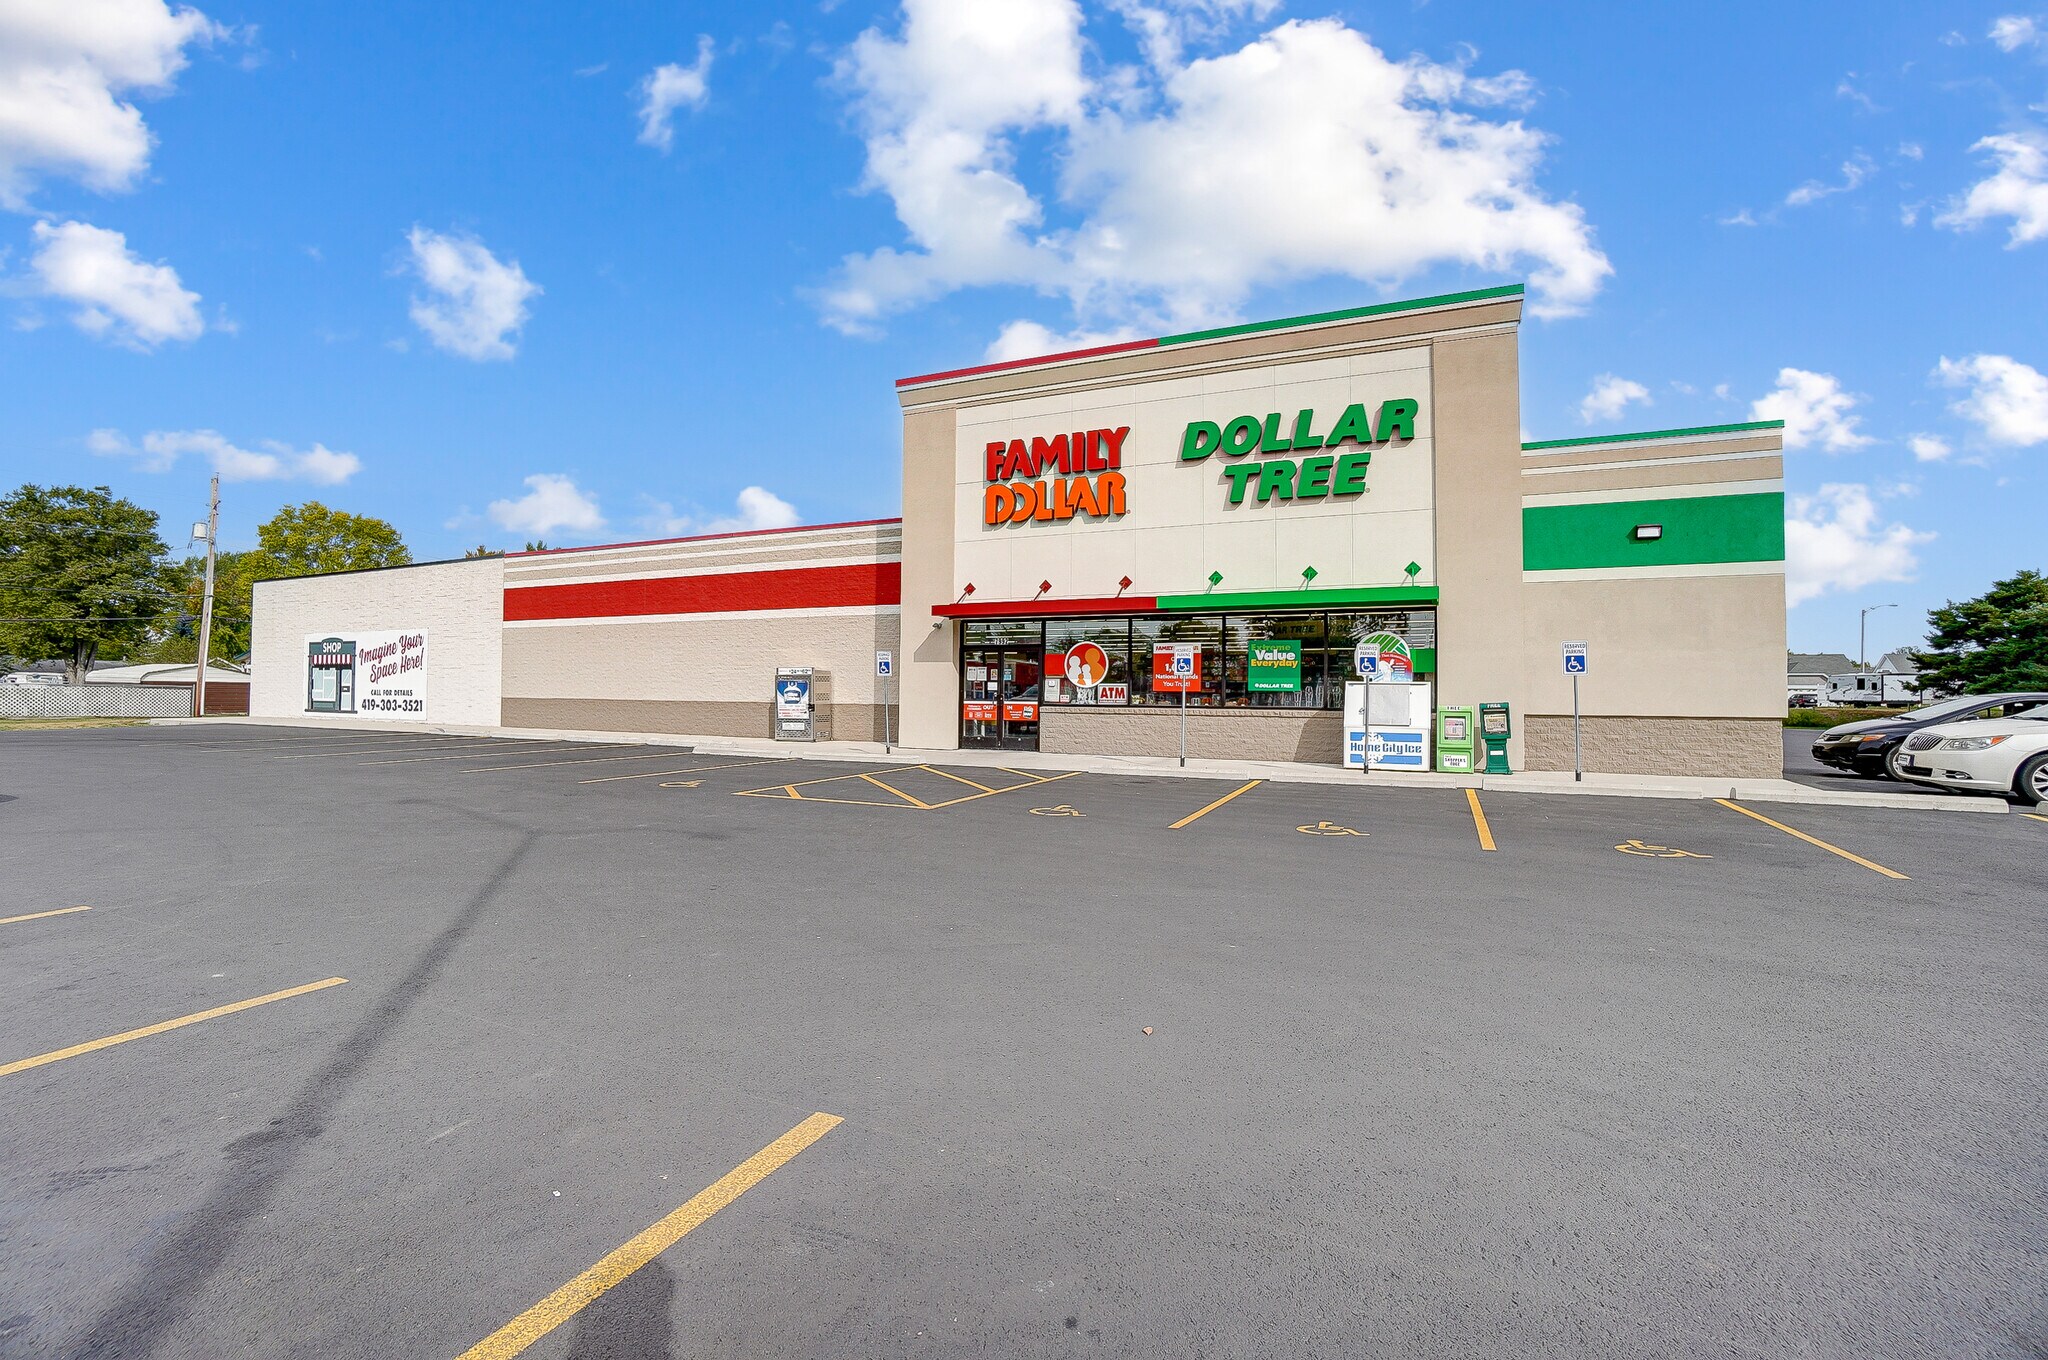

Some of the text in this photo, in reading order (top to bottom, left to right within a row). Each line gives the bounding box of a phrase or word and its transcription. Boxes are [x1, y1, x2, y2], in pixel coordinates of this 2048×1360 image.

[1181, 398, 1419, 460] DOLLAR
[986, 426, 1131, 481] FAMILY
[1223, 452, 1371, 504] TREE
[985, 472, 1127, 525] DOLLAR
[322, 642, 342, 653] SHOP
[359, 633, 424, 666] Imagine Your
[1255, 649, 1296, 660] Value
[370, 647, 425, 684] Space Here!
[1251, 659, 1298, 668] Everyday
[1100, 687, 1125, 699] ATM
[361, 699, 423, 712] 419-303-3521
[1350, 742, 1422, 755] Home City Ice
